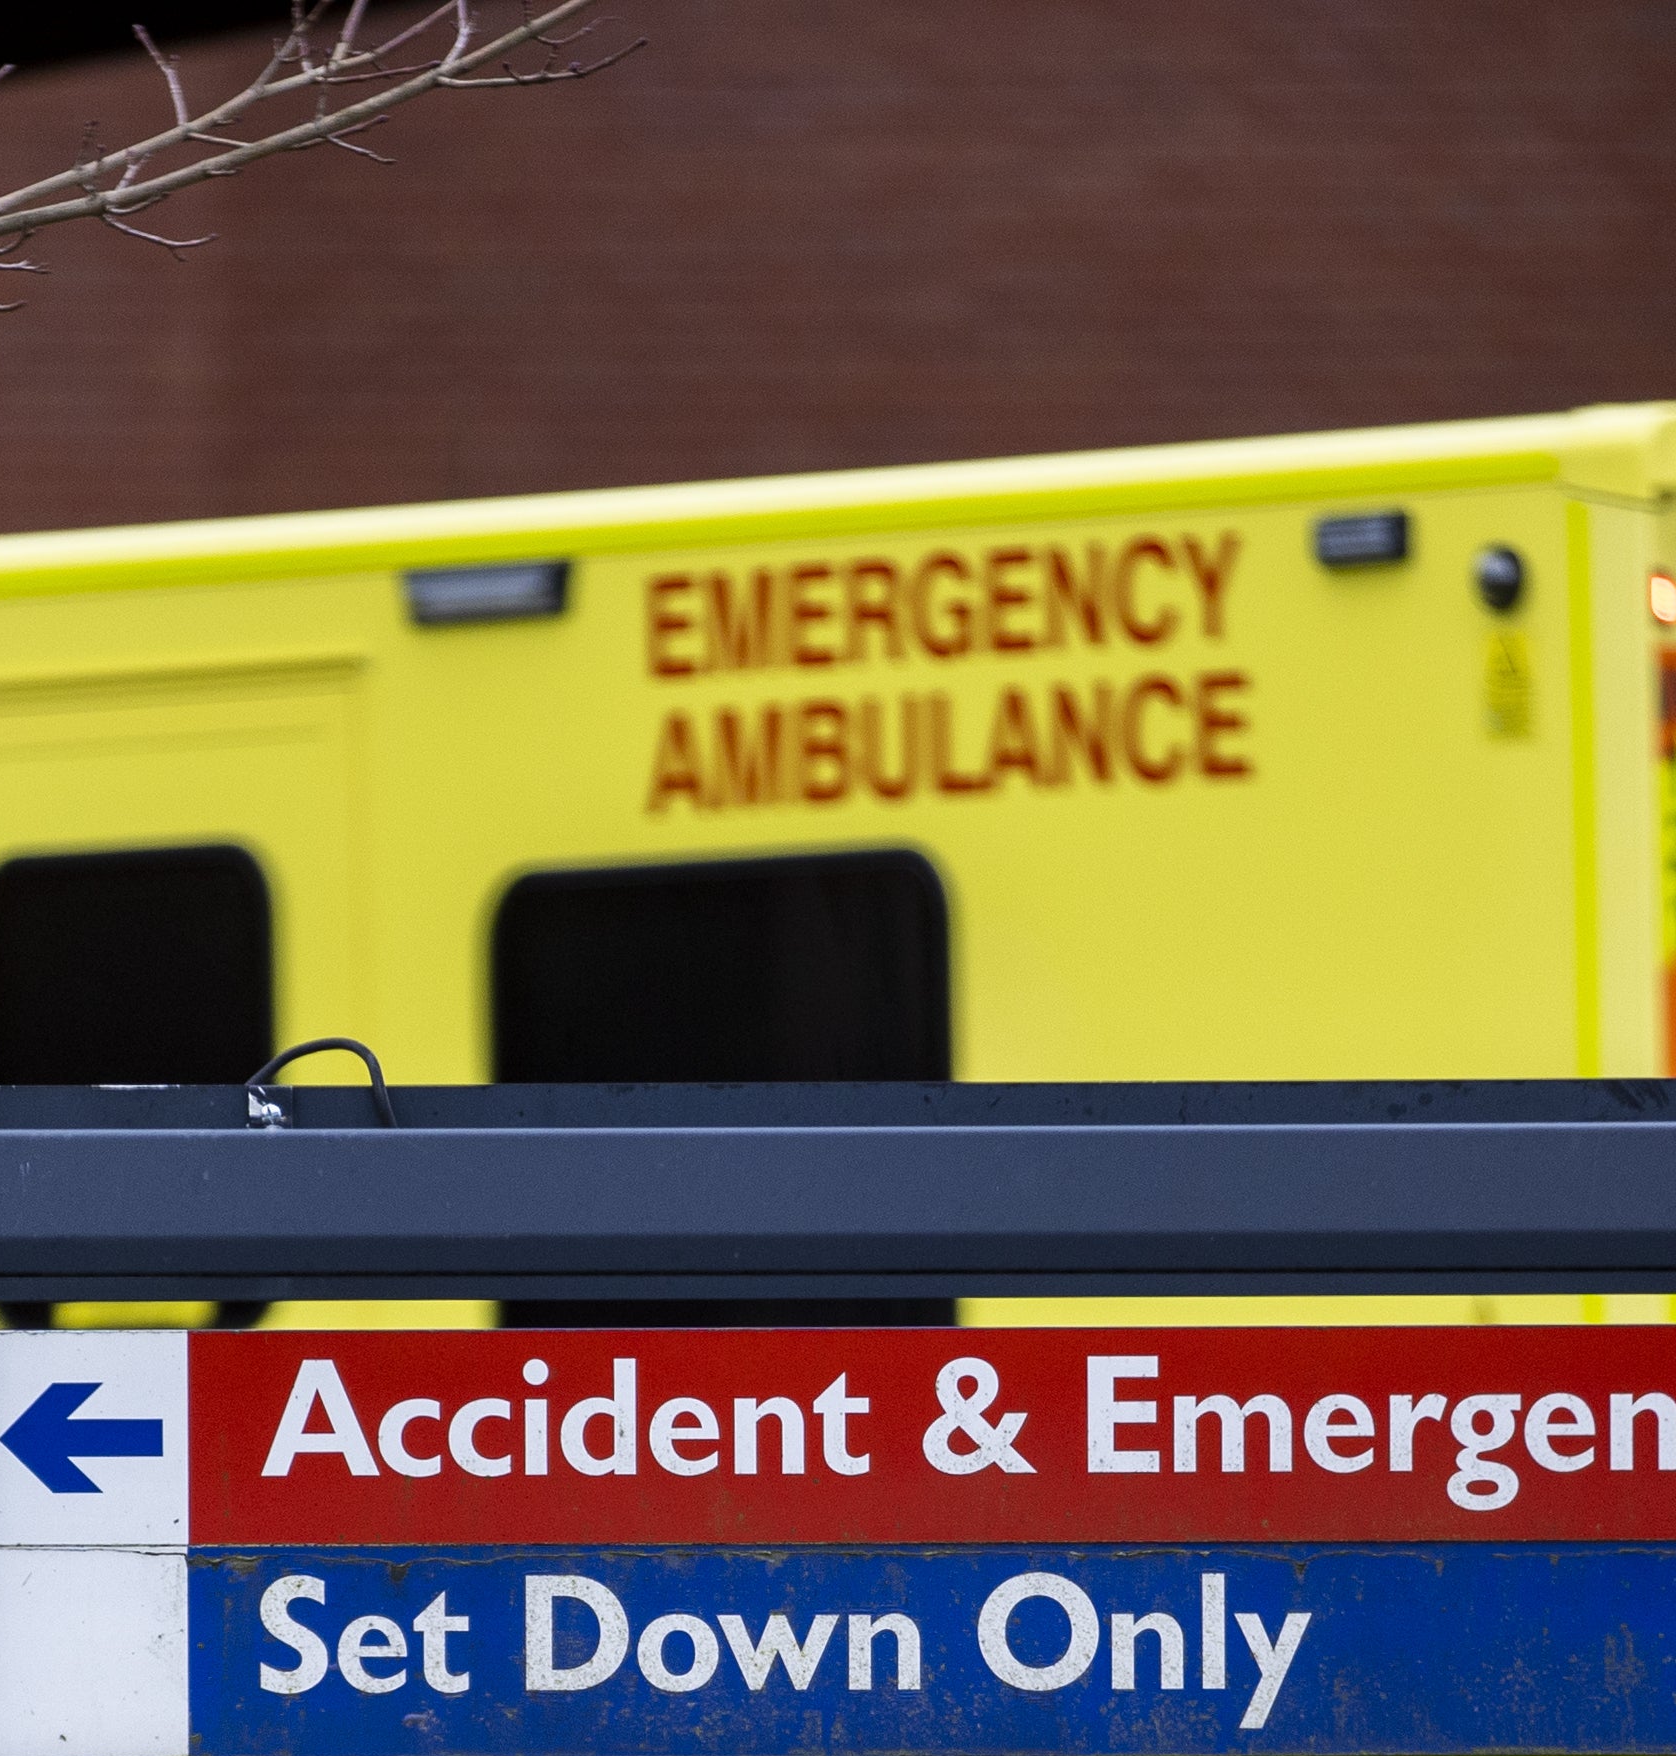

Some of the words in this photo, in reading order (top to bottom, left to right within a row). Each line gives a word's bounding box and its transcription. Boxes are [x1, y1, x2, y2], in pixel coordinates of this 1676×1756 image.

[649, 534, 1241, 682] EMERGENCY
[648, 670, 1255, 812] AMBULANCE
[261, 1358, 869, 1477] Accident
[923, 1357, 1036, 1475] &
[260, 1575, 469, 1694] Set
[526, 1575, 920, 1692] Down
[978, 1572, 1311, 1728] Only
